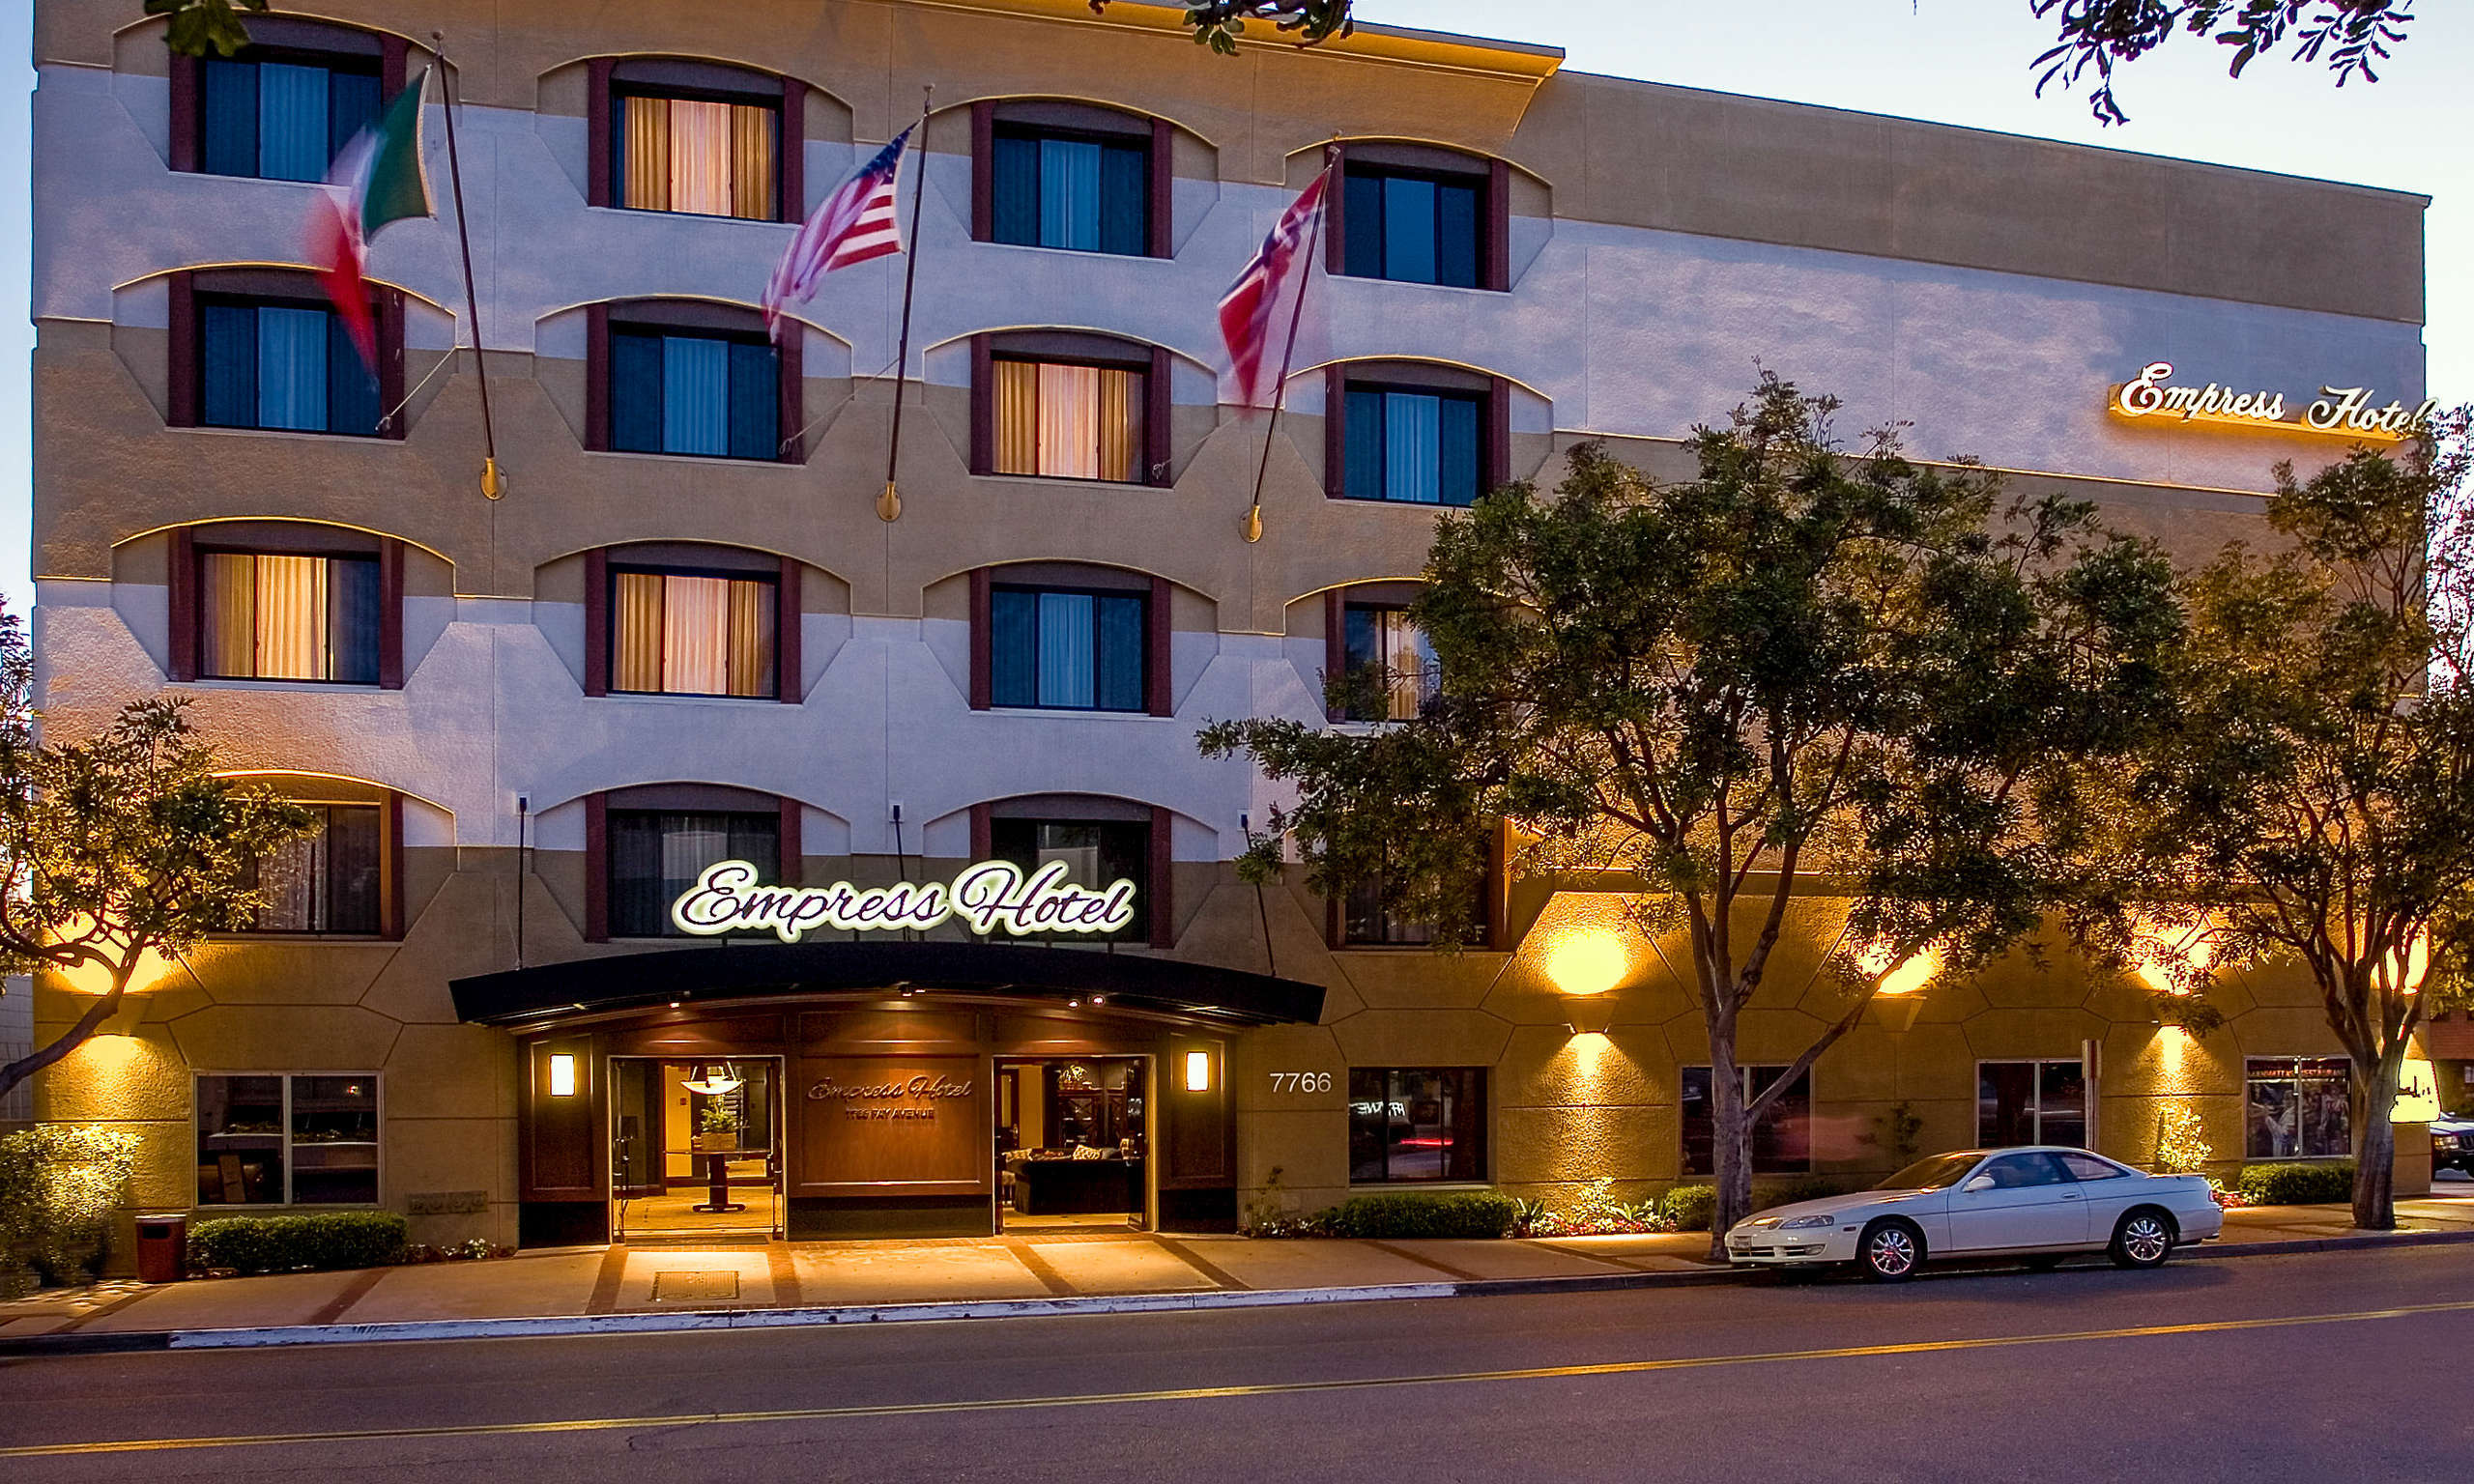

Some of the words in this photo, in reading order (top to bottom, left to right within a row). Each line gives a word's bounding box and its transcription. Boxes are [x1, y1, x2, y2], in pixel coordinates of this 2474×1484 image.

[2119, 361, 2286, 424] Empress
[2306, 385, 2440, 432] Hotel
[675, 862, 948, 940] Empress
[953, 862, 1132, 932] Hotel
[808, 1076, 905, 1102] Empress
[907, 1074, 972, 1099] Hotel
[1269, 1072, 1332, 1093] 7766
[872, 1107, 890, 1121] FAY
[890, 1107, 935, 1121] AVENUE
